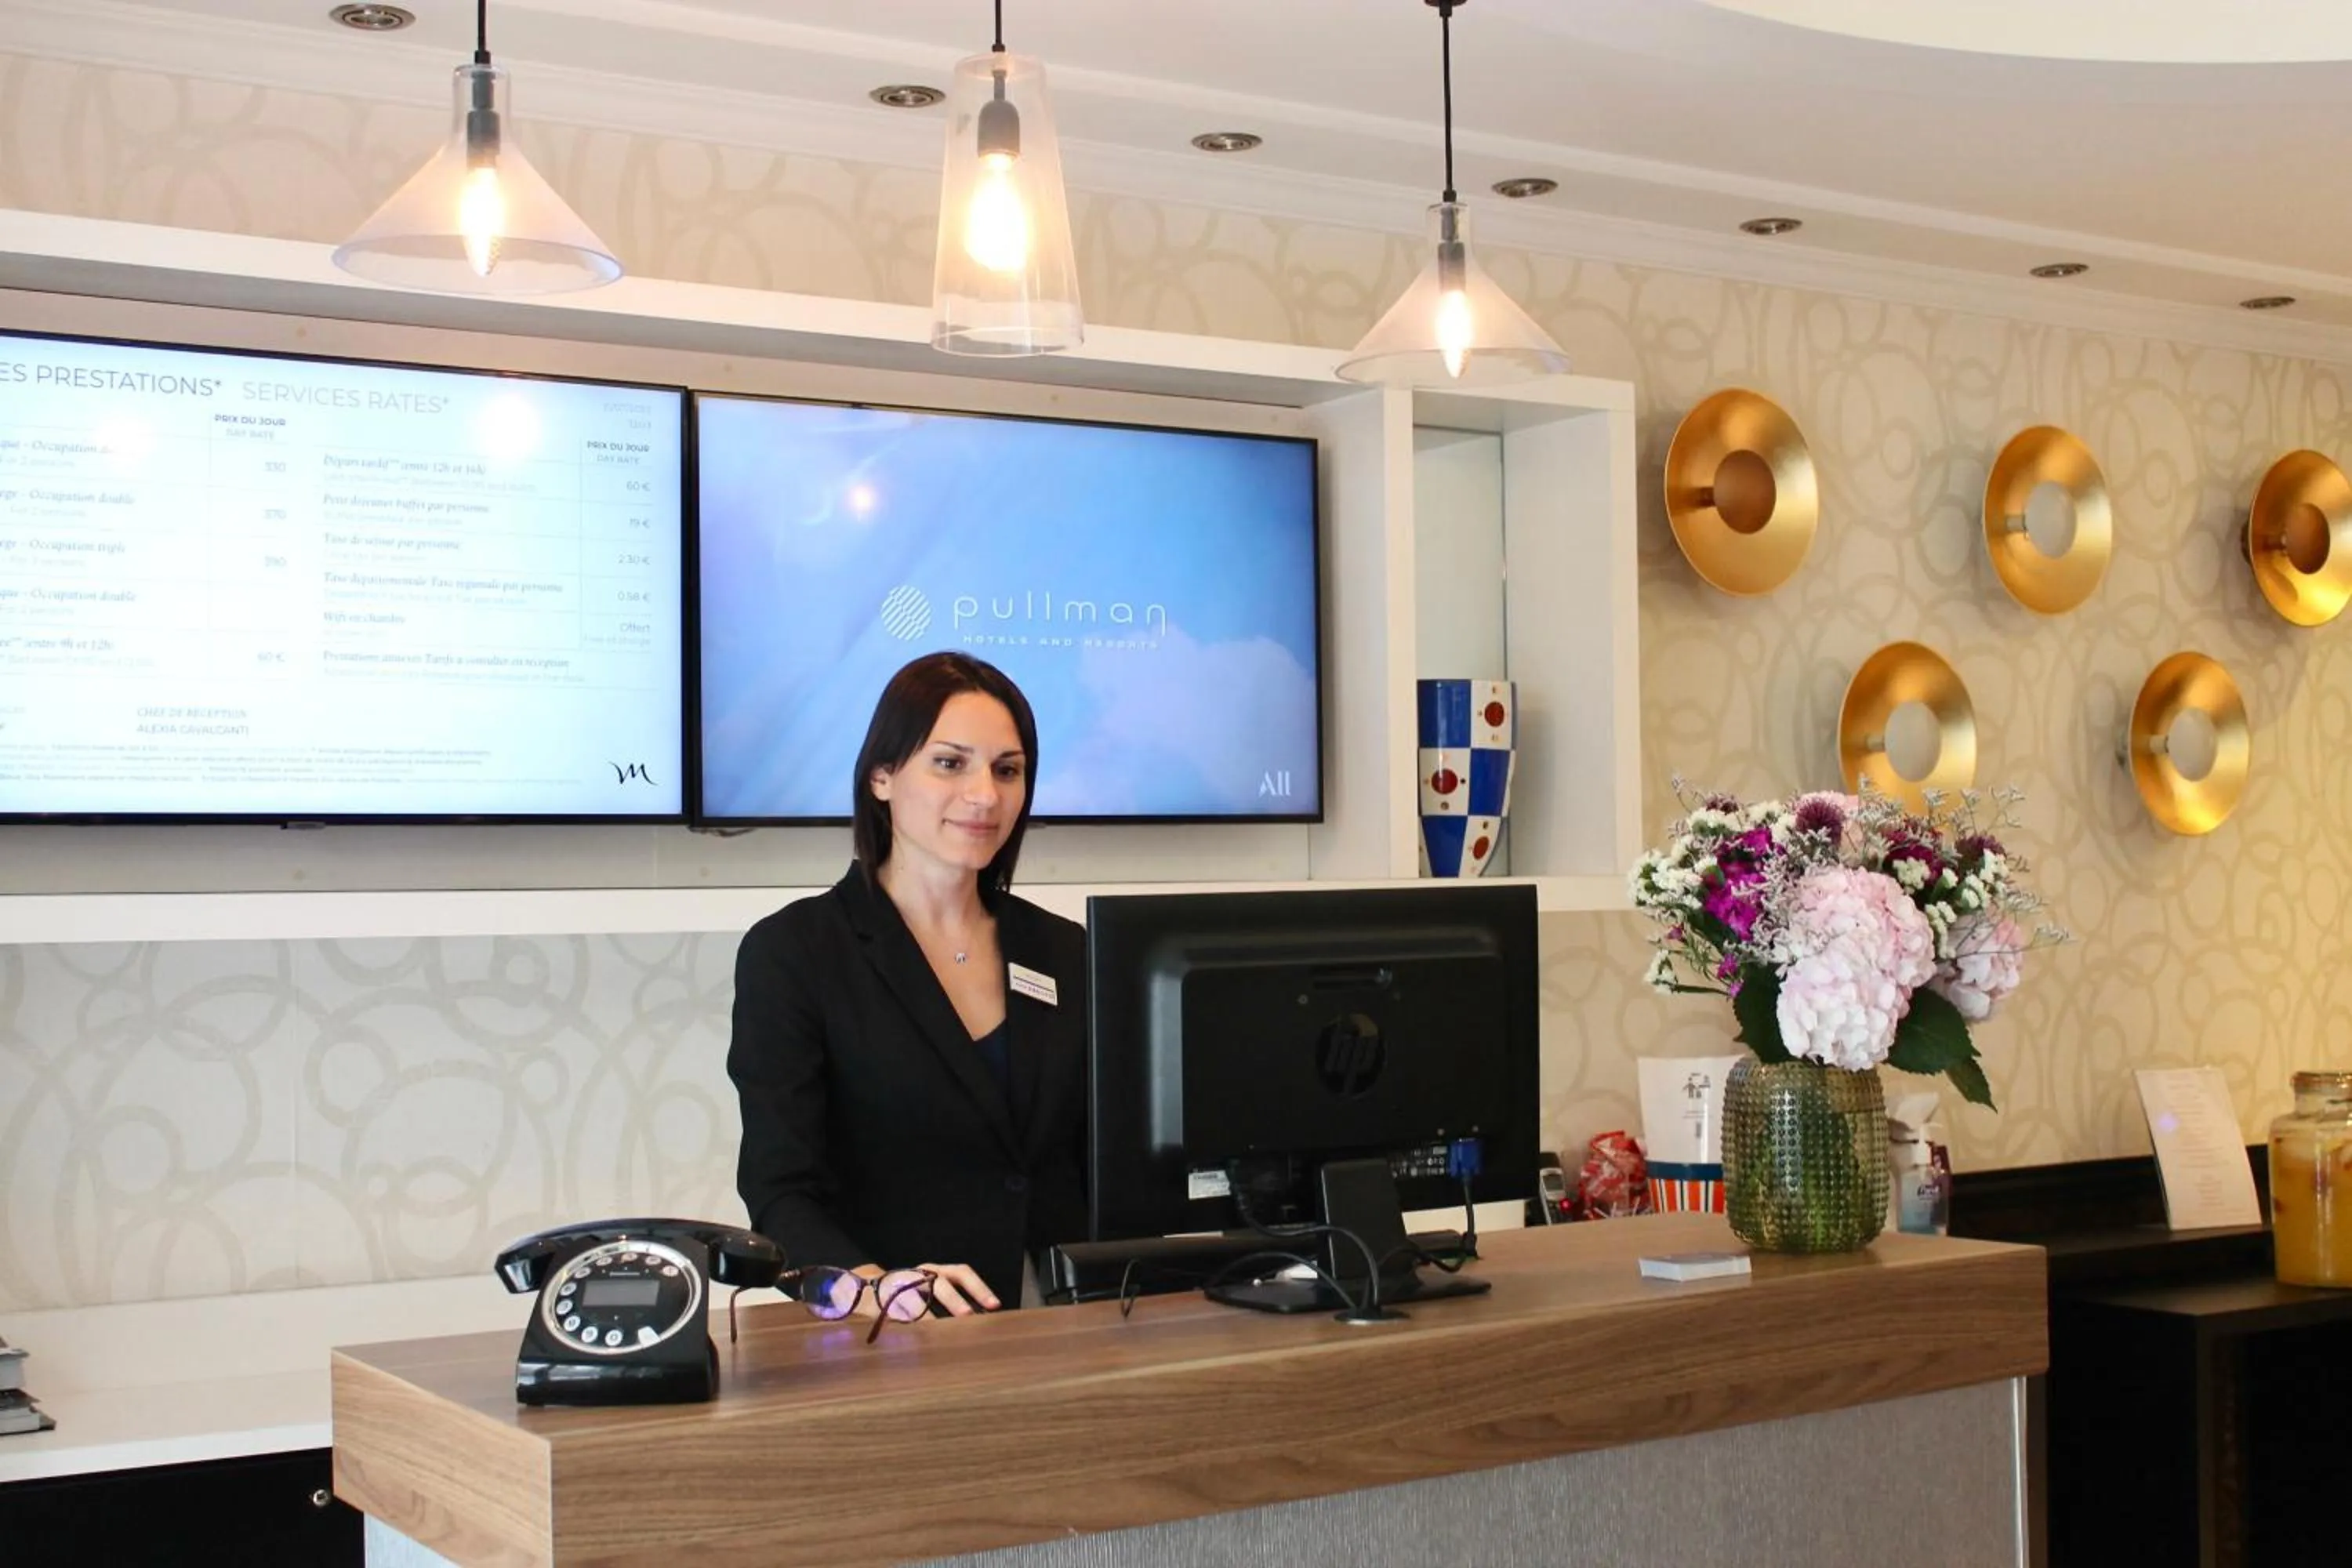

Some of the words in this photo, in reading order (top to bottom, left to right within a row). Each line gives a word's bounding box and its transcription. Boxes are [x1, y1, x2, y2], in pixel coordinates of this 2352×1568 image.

[242, 382, 361, 408] SERVICES
[241, 416, 257, 425] DU
[610, 442, 624, 452] DU
[626, 481, 641, 491] 60
[953, 590, 1168, 638] pullman
[962, 635, 1029, 645] HOTELS
[1039, 639, 1073, 648] AND
